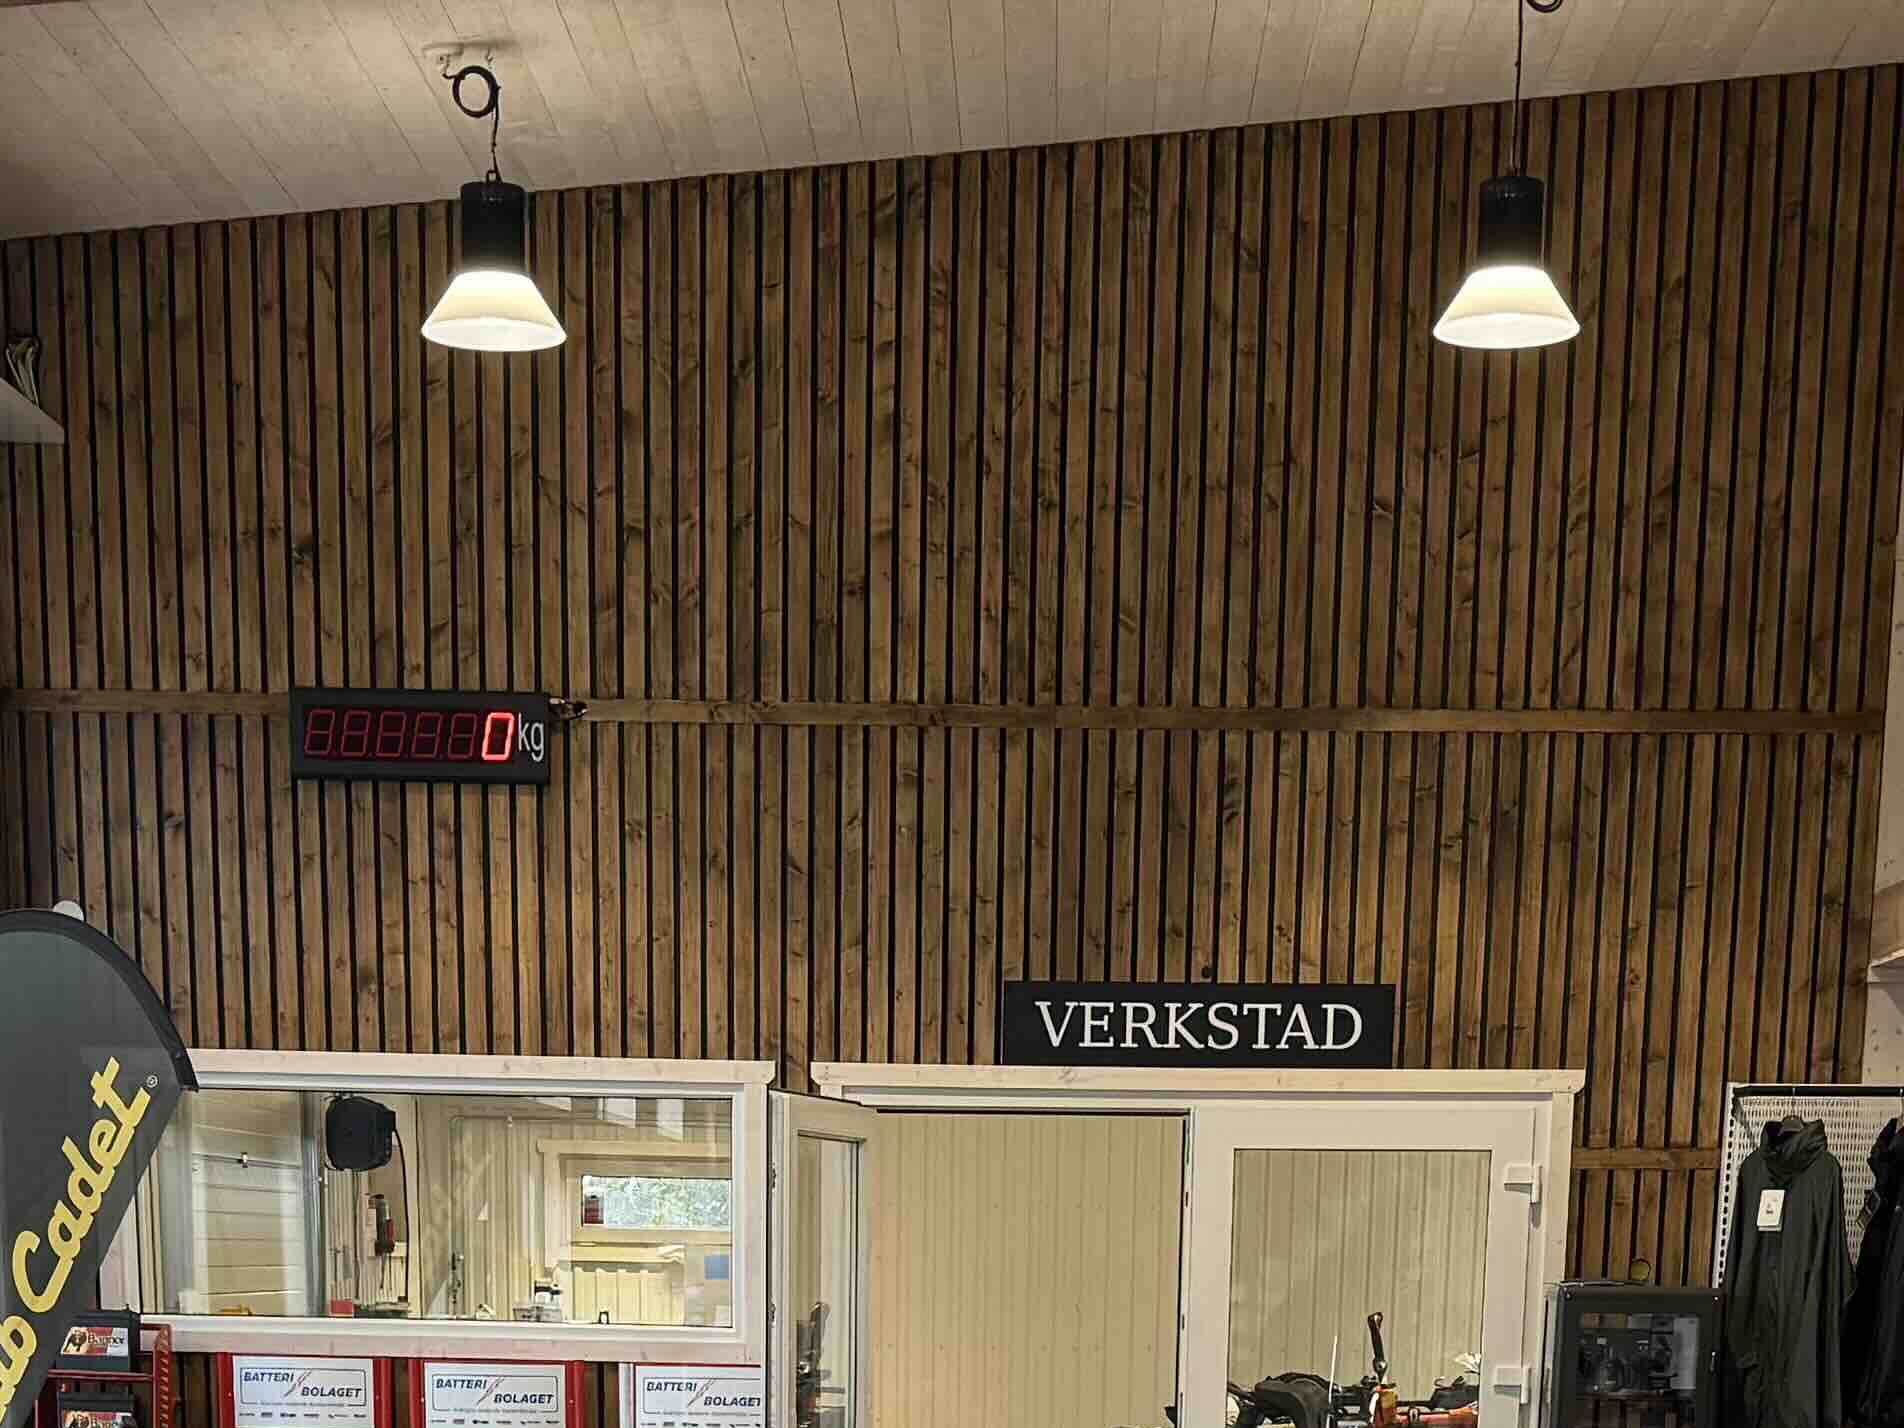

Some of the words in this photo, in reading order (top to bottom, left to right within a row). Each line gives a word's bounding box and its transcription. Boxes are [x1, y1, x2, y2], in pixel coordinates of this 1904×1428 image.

[481, 711, 514, 761] 0
[518, 712, 545, 762] kg
[1034, 1001, 1364, 1052] VERKSTAD
[11, 1056, 151, 1314] Cadet
[244, 1372, 295, 1383] BATTERI
[436, 1378, 488, 1390] BATTERI
[647, 1381, 698, 1392] BATTERI
[301, 1386, 362, 1398] BOLAGET
[493, 1393, 555, 1404] BOLAGET
